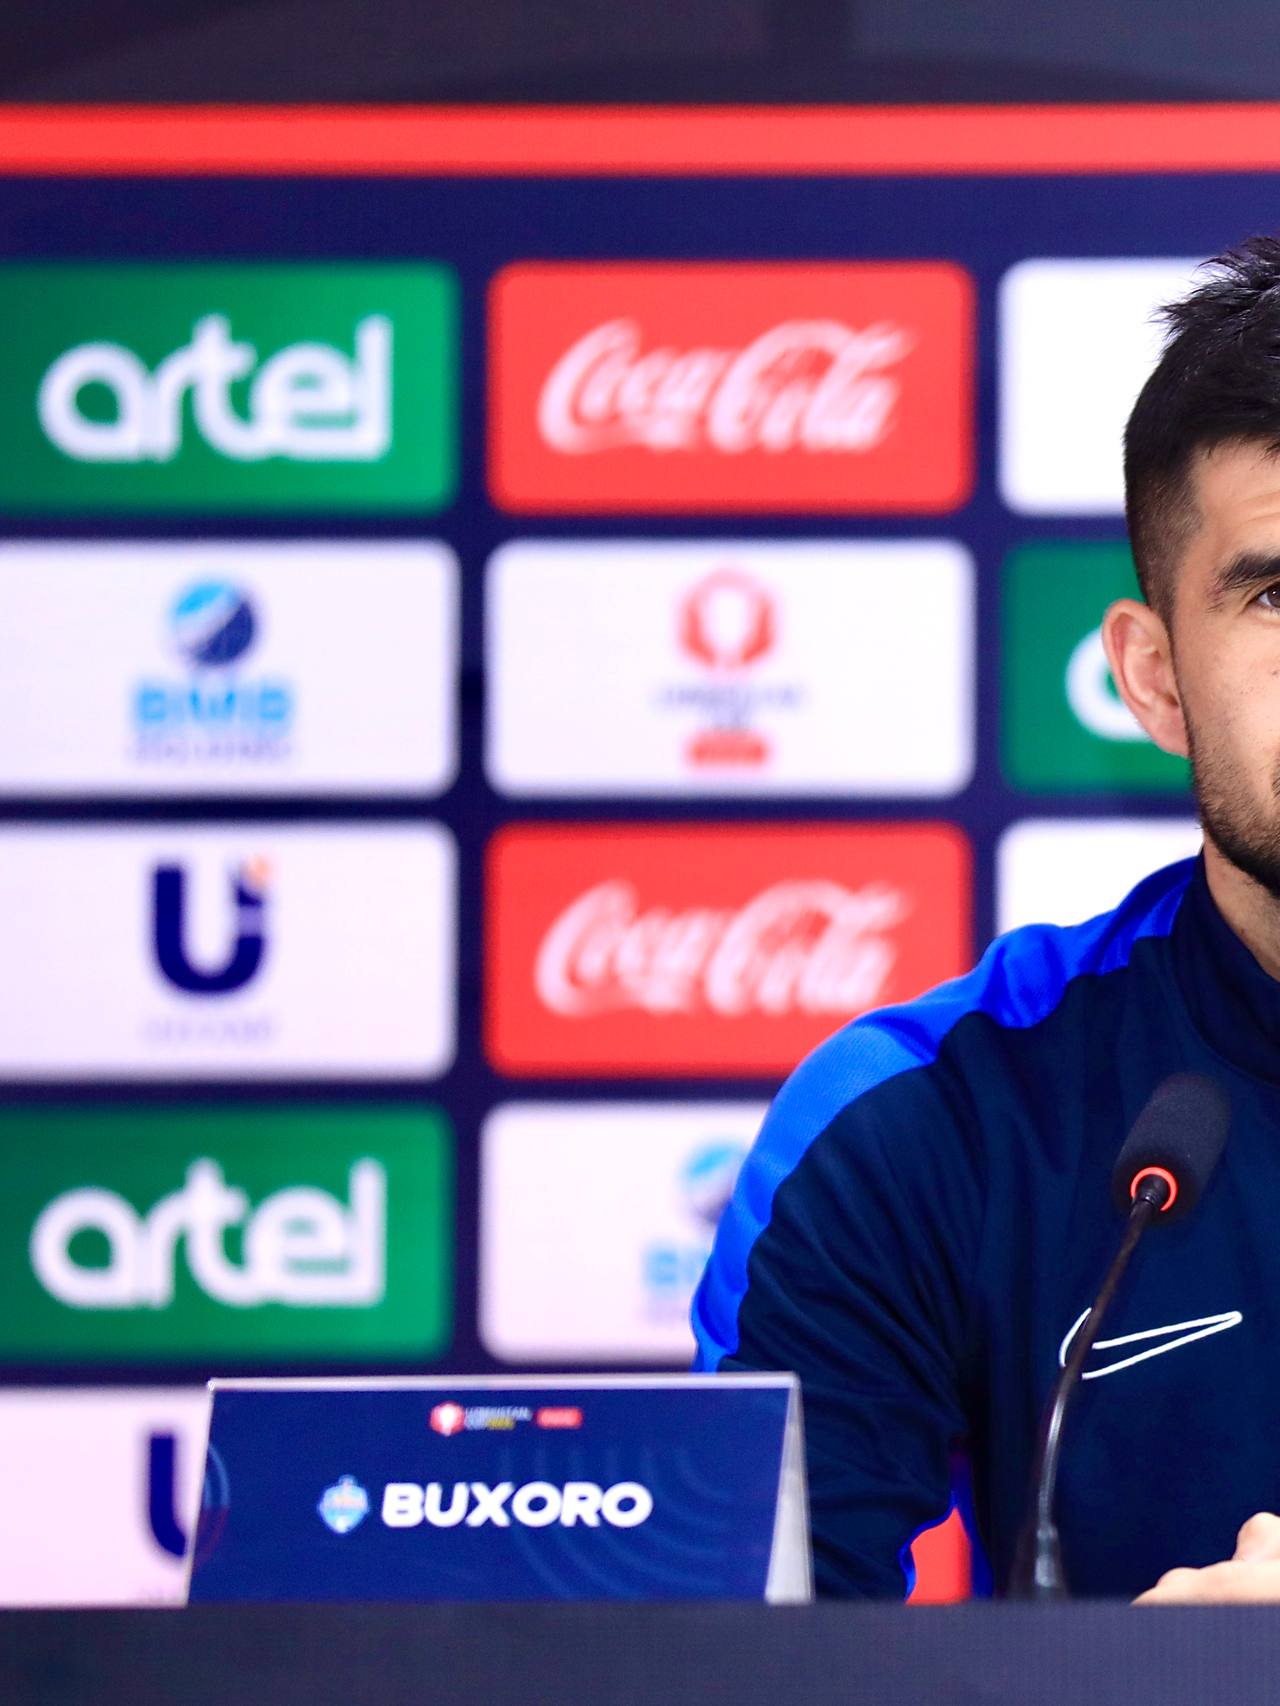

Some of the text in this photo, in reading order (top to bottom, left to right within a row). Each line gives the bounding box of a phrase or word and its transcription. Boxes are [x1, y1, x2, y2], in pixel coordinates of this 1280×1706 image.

[38, 312, 393, 464] artel
[30, 1155, 386, 1310] artel
[382, 1481, 653, 1528] BUXORO
